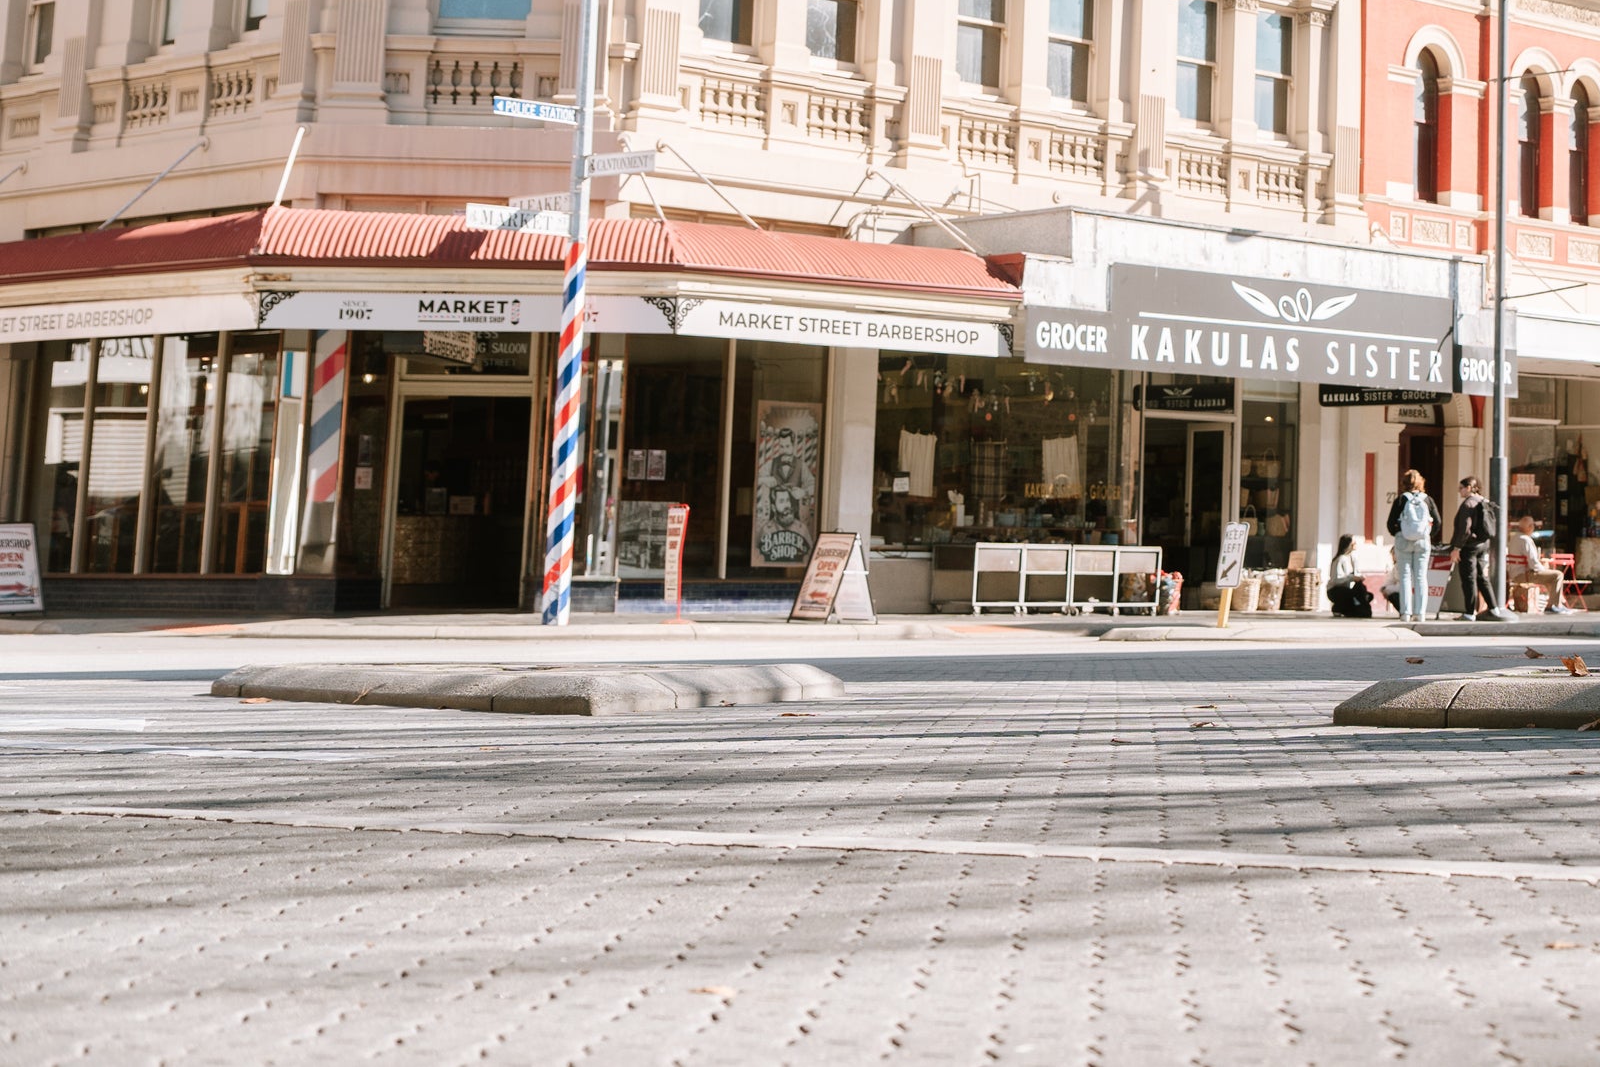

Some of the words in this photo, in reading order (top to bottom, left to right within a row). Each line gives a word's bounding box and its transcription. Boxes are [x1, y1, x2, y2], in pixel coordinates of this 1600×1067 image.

[506, 100, 536, 117] POLICE
[540, 104, 575, 122] STATION
[596, 155, 650, 171] CANTONMENT
[519, 195, 562, 212] LEAKE
[481, 209, 552, 231] MARKET
[338, 308, 373, 320] 1907
[418, 299, 509, 314] MARKET
[0, 317, 16, 333] ET
[19, 313, 64, 332] STREET
[67, 308, 153, 329] BARBERSHOP
[718, 310, 794, 331] MARKET
[799, 316, 861, 337] STREET
[867, 322, 979, 345] BARBERSHOP
[1035, 320, 1108, 353] GROCER
[491, 342, 527, 354] SALOON
[1130, 323, 1301, 372] KAKULAS
[1326, 340, 1443, 383] SISTER
[1459, 357, 1513, 384] GROCR
[1322, 392, 1360, 402] KAKULAS
[1363, 391, 1393, 401] SISTER
[1401, 390, 1437, 400] GROCER
[760, 531, 807, 553] BARBER
[1225, 529, 1244, 540] KEEP
[0, 538, 31, 550] ERSHOP
[770, 544, 798, 560] SHOP
[1223, 543, 1241, 553] LEFT
[817, 560, 839, 571] OPEN
